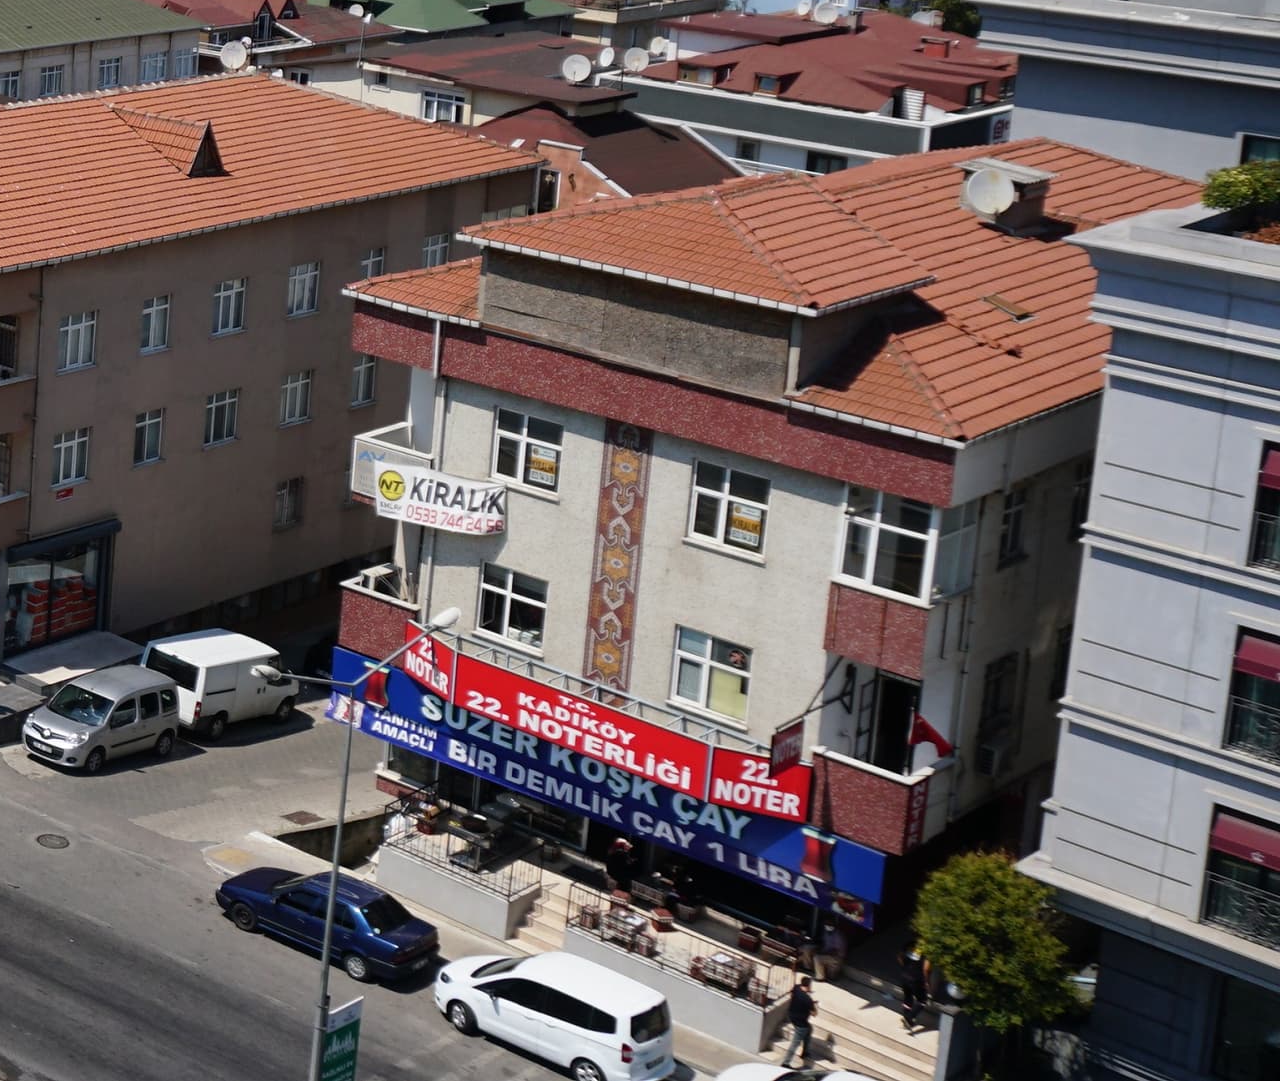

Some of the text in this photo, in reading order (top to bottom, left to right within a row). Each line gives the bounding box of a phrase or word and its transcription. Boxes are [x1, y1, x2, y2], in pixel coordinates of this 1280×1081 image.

[380, 478, 404, 493] NT
[406, 504, 438, 525] 0533
[440, 511, 464, 529] 744
[465, 515, 482, 533] 24
[516, 691, 637, 745] KADIKÖY
[558, 694, 596, 717] T.C.
[371, 720, 435, 752] AMAÇLI
[466, 690, 691, 790] 22. NOTERLİĞİ
[741, 758, 779, 787] 22.
[671, 789, 753, 841] ÇAY
[713, 777, 801, 818] NOTER
[447, 738, 819, 900] BİR DEMLİK ÇAY 1 LİRA
